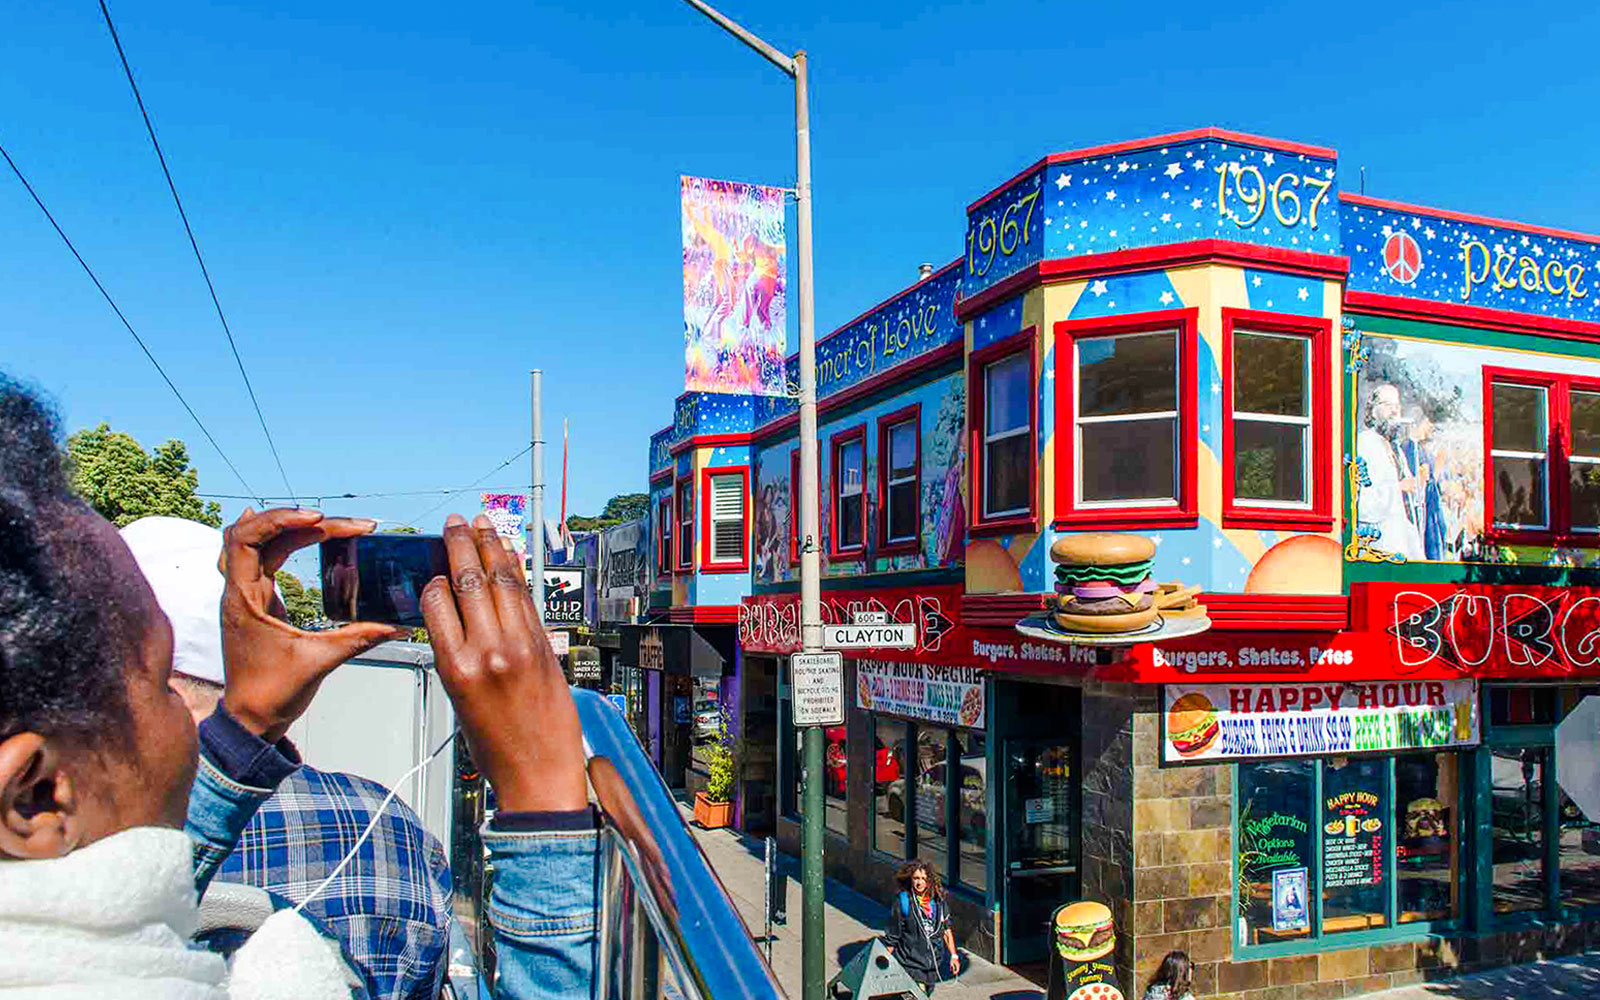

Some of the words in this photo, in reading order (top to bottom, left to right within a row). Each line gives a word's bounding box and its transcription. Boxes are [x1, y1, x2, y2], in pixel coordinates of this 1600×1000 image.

[1214, 161, 1332, 230] 1967
[968, 188, 1041, 276] 1967
[1459, 241, 1588, 300] Peace
[856, 324, 878, 373] of
[883, 305, 938, 356] Love
[544, 601, 582, 612] UID
[545, 611, 581, 621] RIENCE
[857, 613, 876, 624] 600
[834, 629, 904, 644] CLAYTON
[1153, 647, 1233, 673] Burgers,
[1238, 647, 1305, 667] Shakes,
[1309, 646, 1353, 666] Fries
[811, 706, 836, 714] SIDEWALK
[1228, 685, 1344, 714] HAPPY
[1358, 681, 1446, 709] HOUR
[1261, 718, 1288, 754] FRIES
[1289, 717, 1297, 753] &
[1296, 716, 1326, 752] DRINK
[1355, 714, 1382, 750] BEER
[1326, 791, 1355, 811] HAPPY
[1356, 791, 1378, 807] HOUR
[1247, 811, 1309, 837] Vegetarian
[1258, 837, 1295, 852] Options
